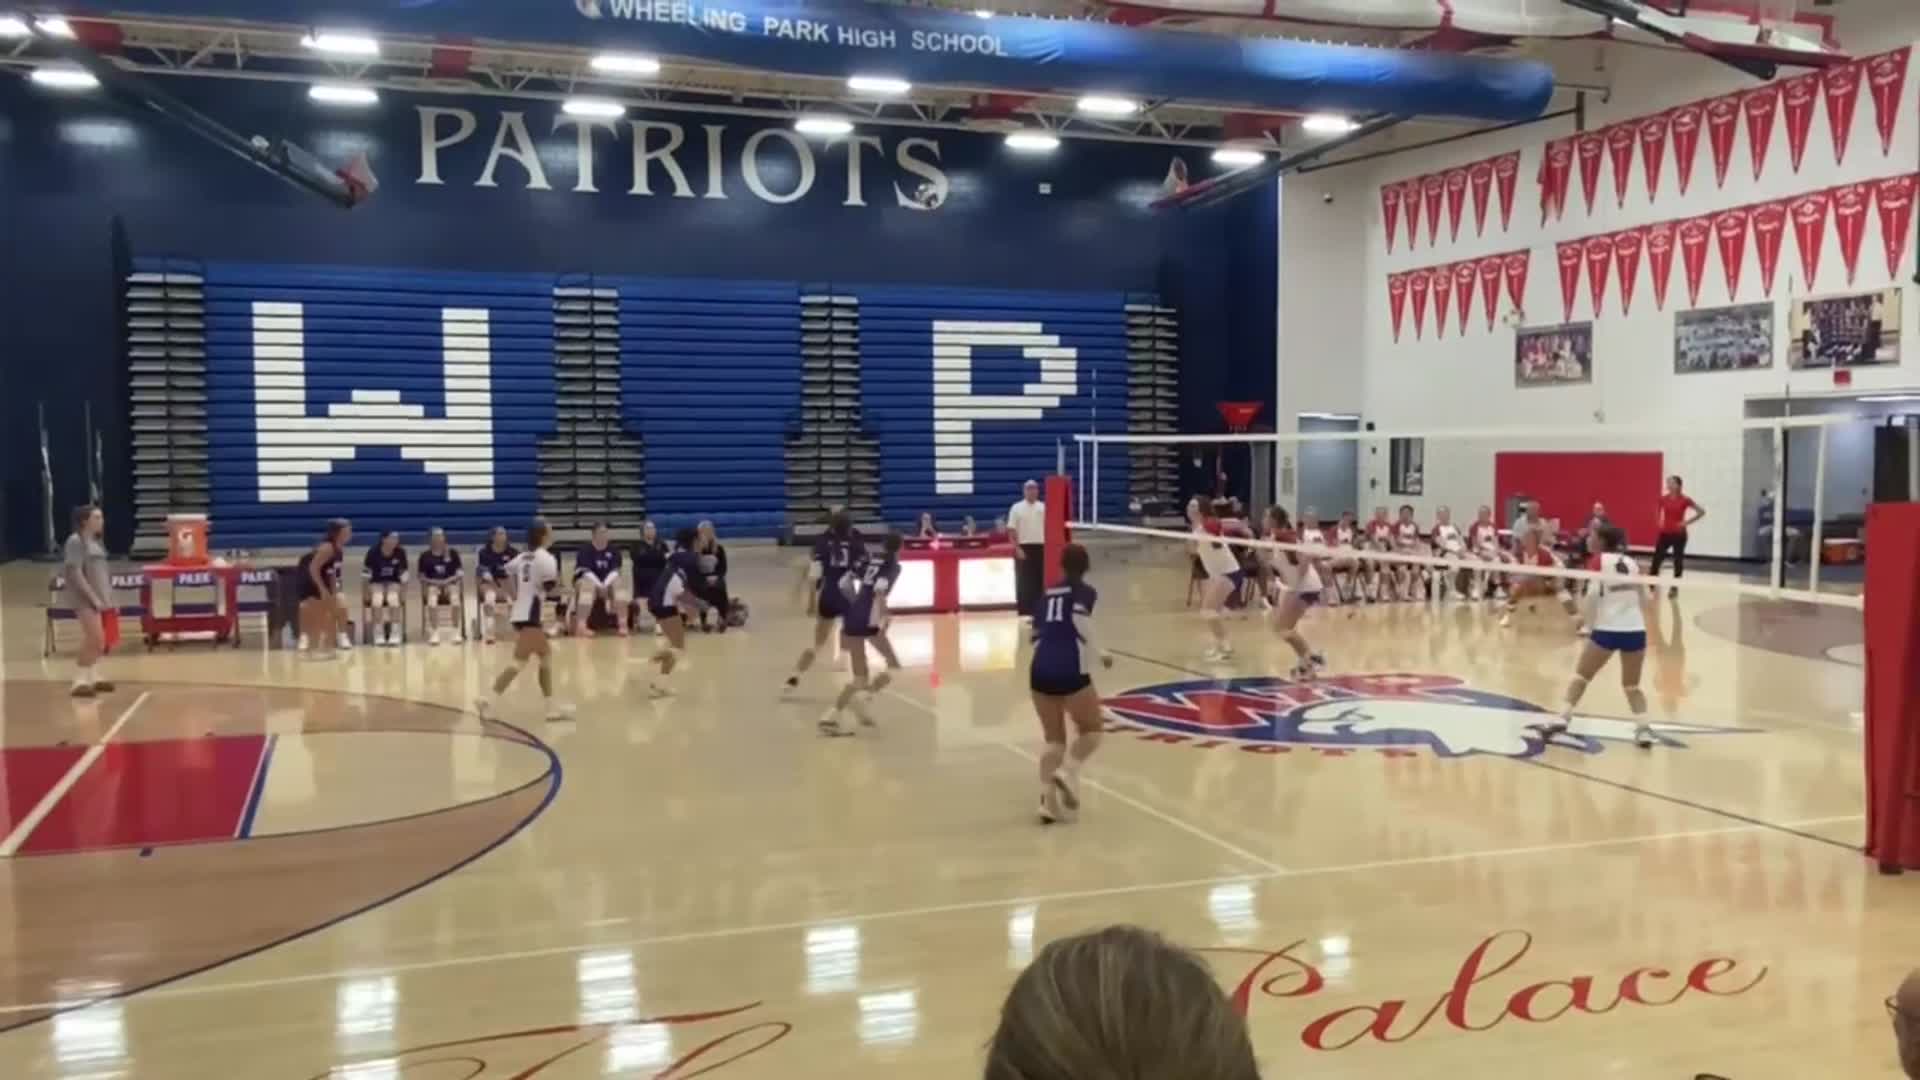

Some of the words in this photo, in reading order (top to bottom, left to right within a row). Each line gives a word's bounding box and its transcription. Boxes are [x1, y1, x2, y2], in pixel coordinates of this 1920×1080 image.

[610, 0, 746, 32] WHEELING
[763, 15, 829, 43] PARK
[837, 25, 897, 48] HIGH
[911, 30, 1008, 57] SCHOOL
[416, 105, 949, 211] PATRIOTS
[1045, 597, 1063, 622] 11
[1192, 929, 1768, 1052] Palace
